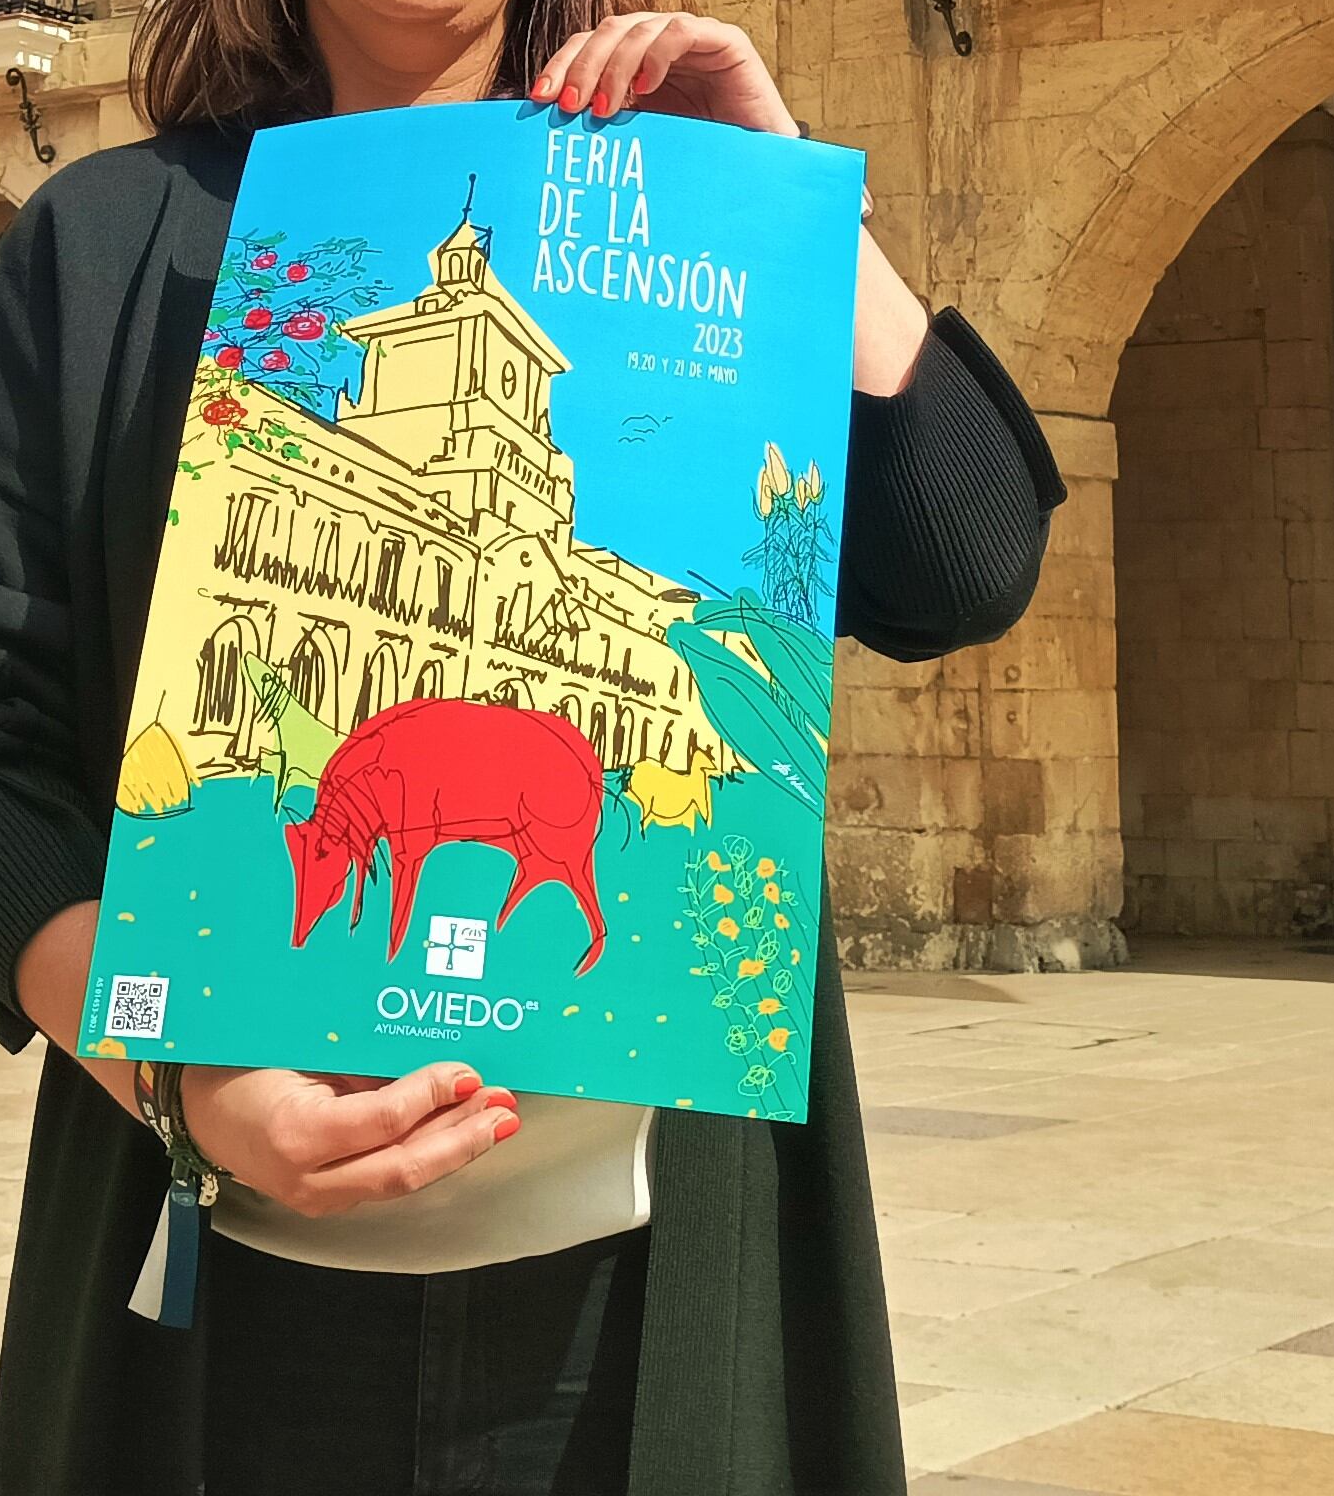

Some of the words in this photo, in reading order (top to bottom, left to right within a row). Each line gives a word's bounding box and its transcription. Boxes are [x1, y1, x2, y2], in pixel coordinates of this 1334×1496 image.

[546, 129, 644, 191] FERIA
[538, 182, 585, 238] DE
[607, 189, 649, 247] LA
[532, 238, 747, 319] ASCENSIÓN
[693, 323, 743, 359] 2023
[662, 357, 669, 374] Y
[674, 359, 685, 376] 21
[688, 360, 703, 378] DE
[708, 364, 738, 385] MAYO
[373, 1023, 462, 1042] AYUNTAMIENTO
